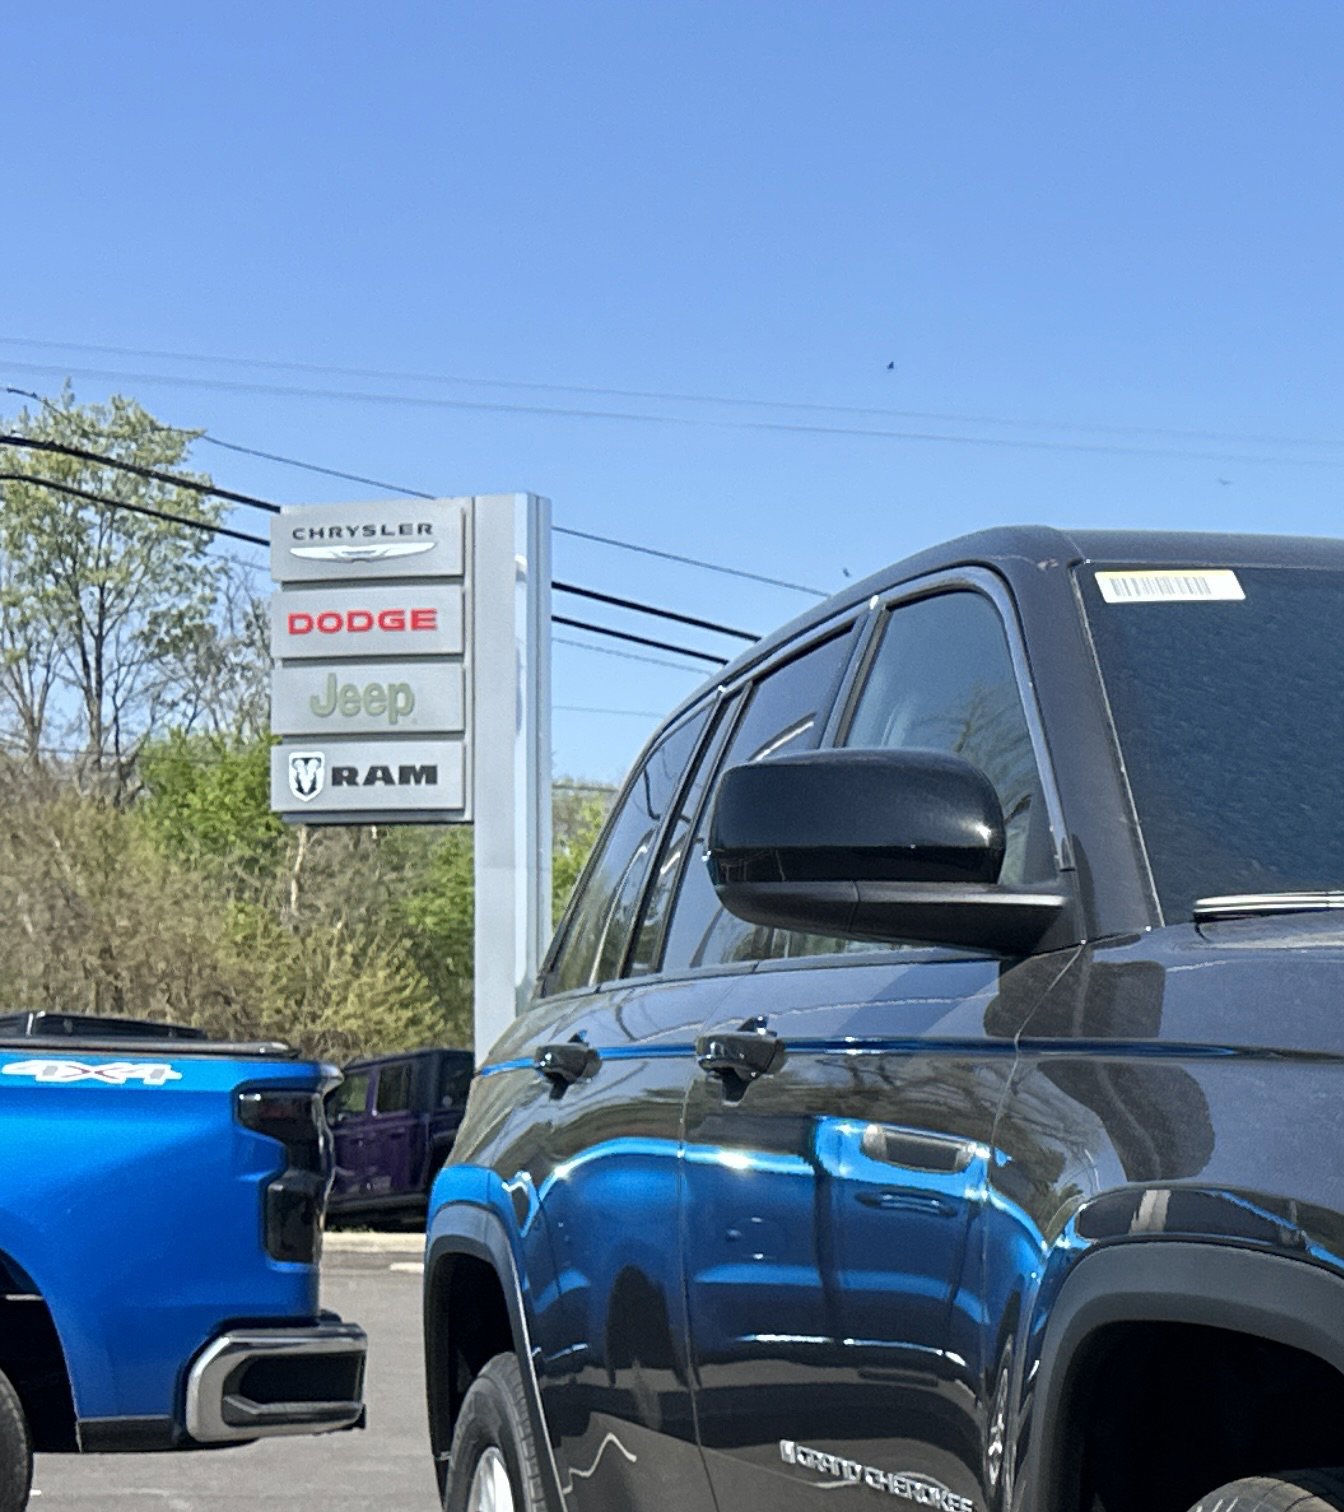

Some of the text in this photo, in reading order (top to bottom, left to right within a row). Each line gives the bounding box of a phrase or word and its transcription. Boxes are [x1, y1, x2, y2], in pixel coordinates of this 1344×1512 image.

[292, 523, 434, 541] CHRYSLER
[287, 608, 438, 635] DODGE
[310, 672, 416, 725] Jeep
[331, 764, 438, 787] RAM
[796, 1445, 862, 1482] GRAND
